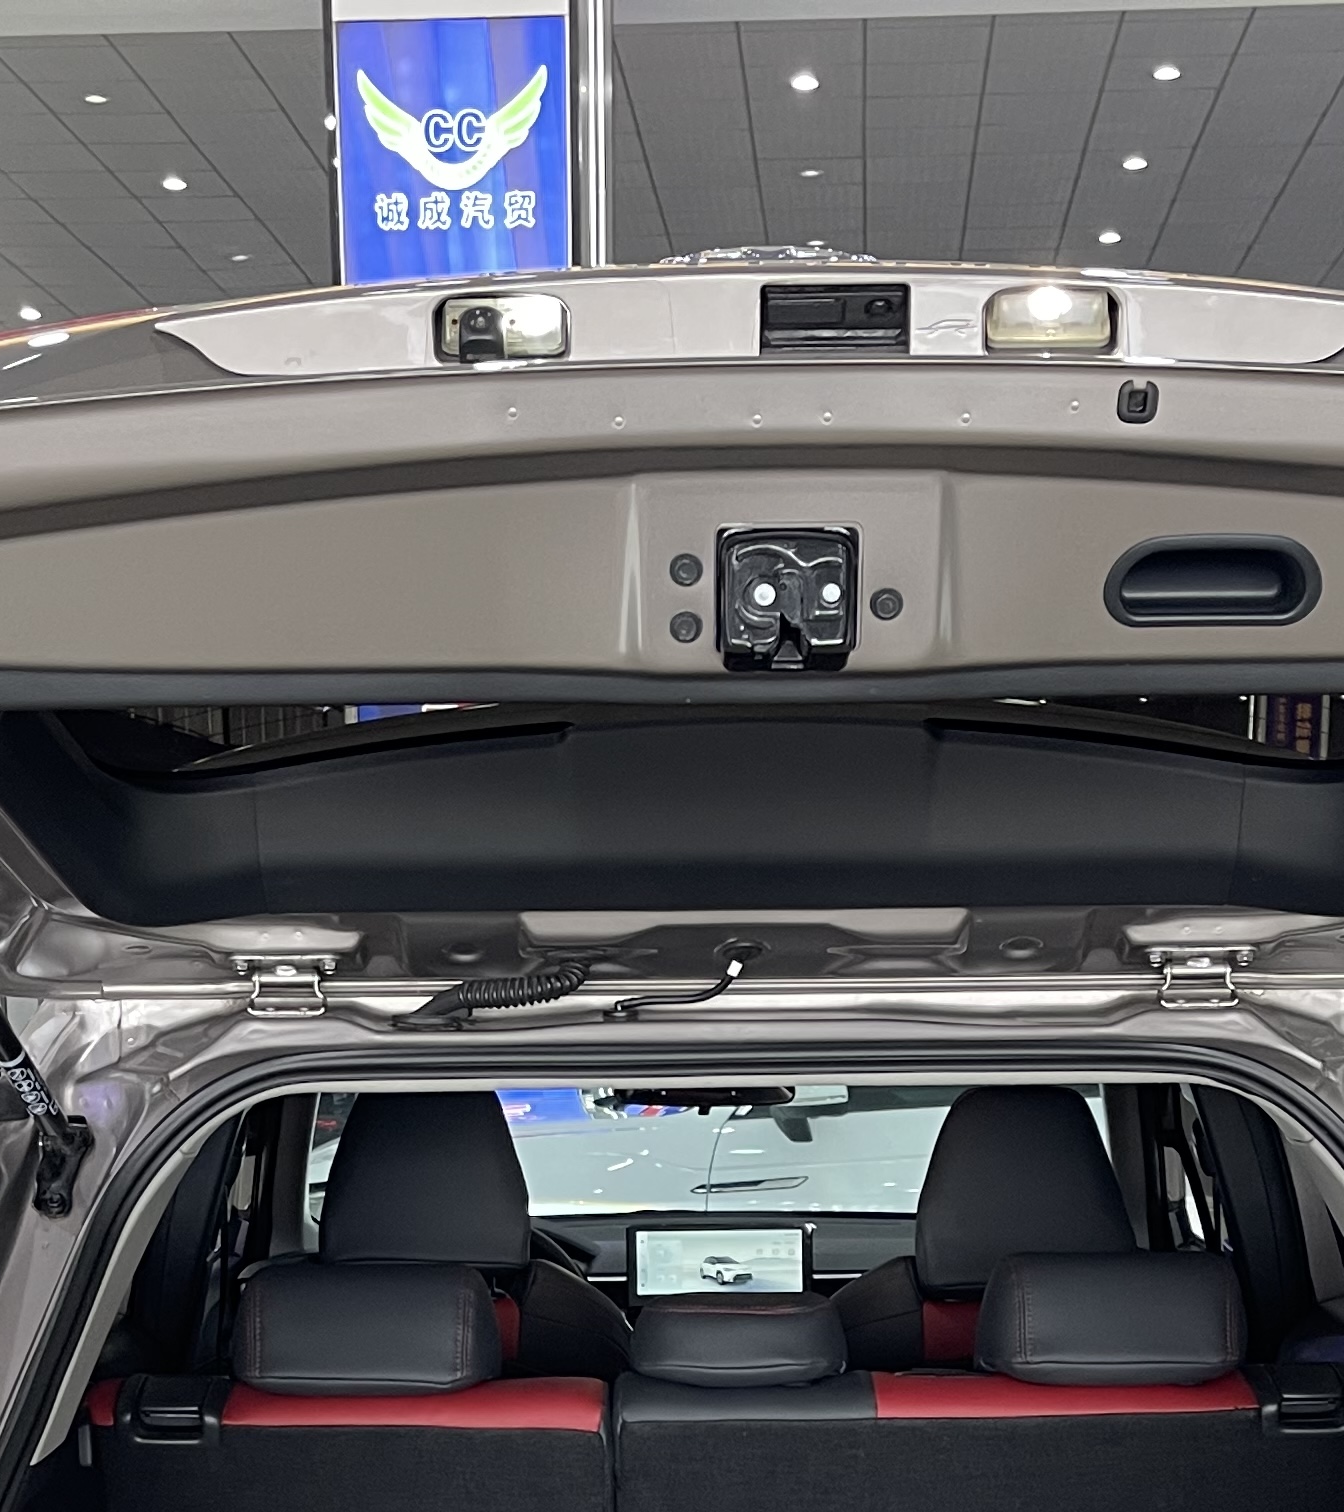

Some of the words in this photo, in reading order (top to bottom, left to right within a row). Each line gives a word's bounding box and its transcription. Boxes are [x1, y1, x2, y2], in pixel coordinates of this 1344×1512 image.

[423, 108, 487, 153] CC
[375, 190, 536, 231] 诚成汽贸
